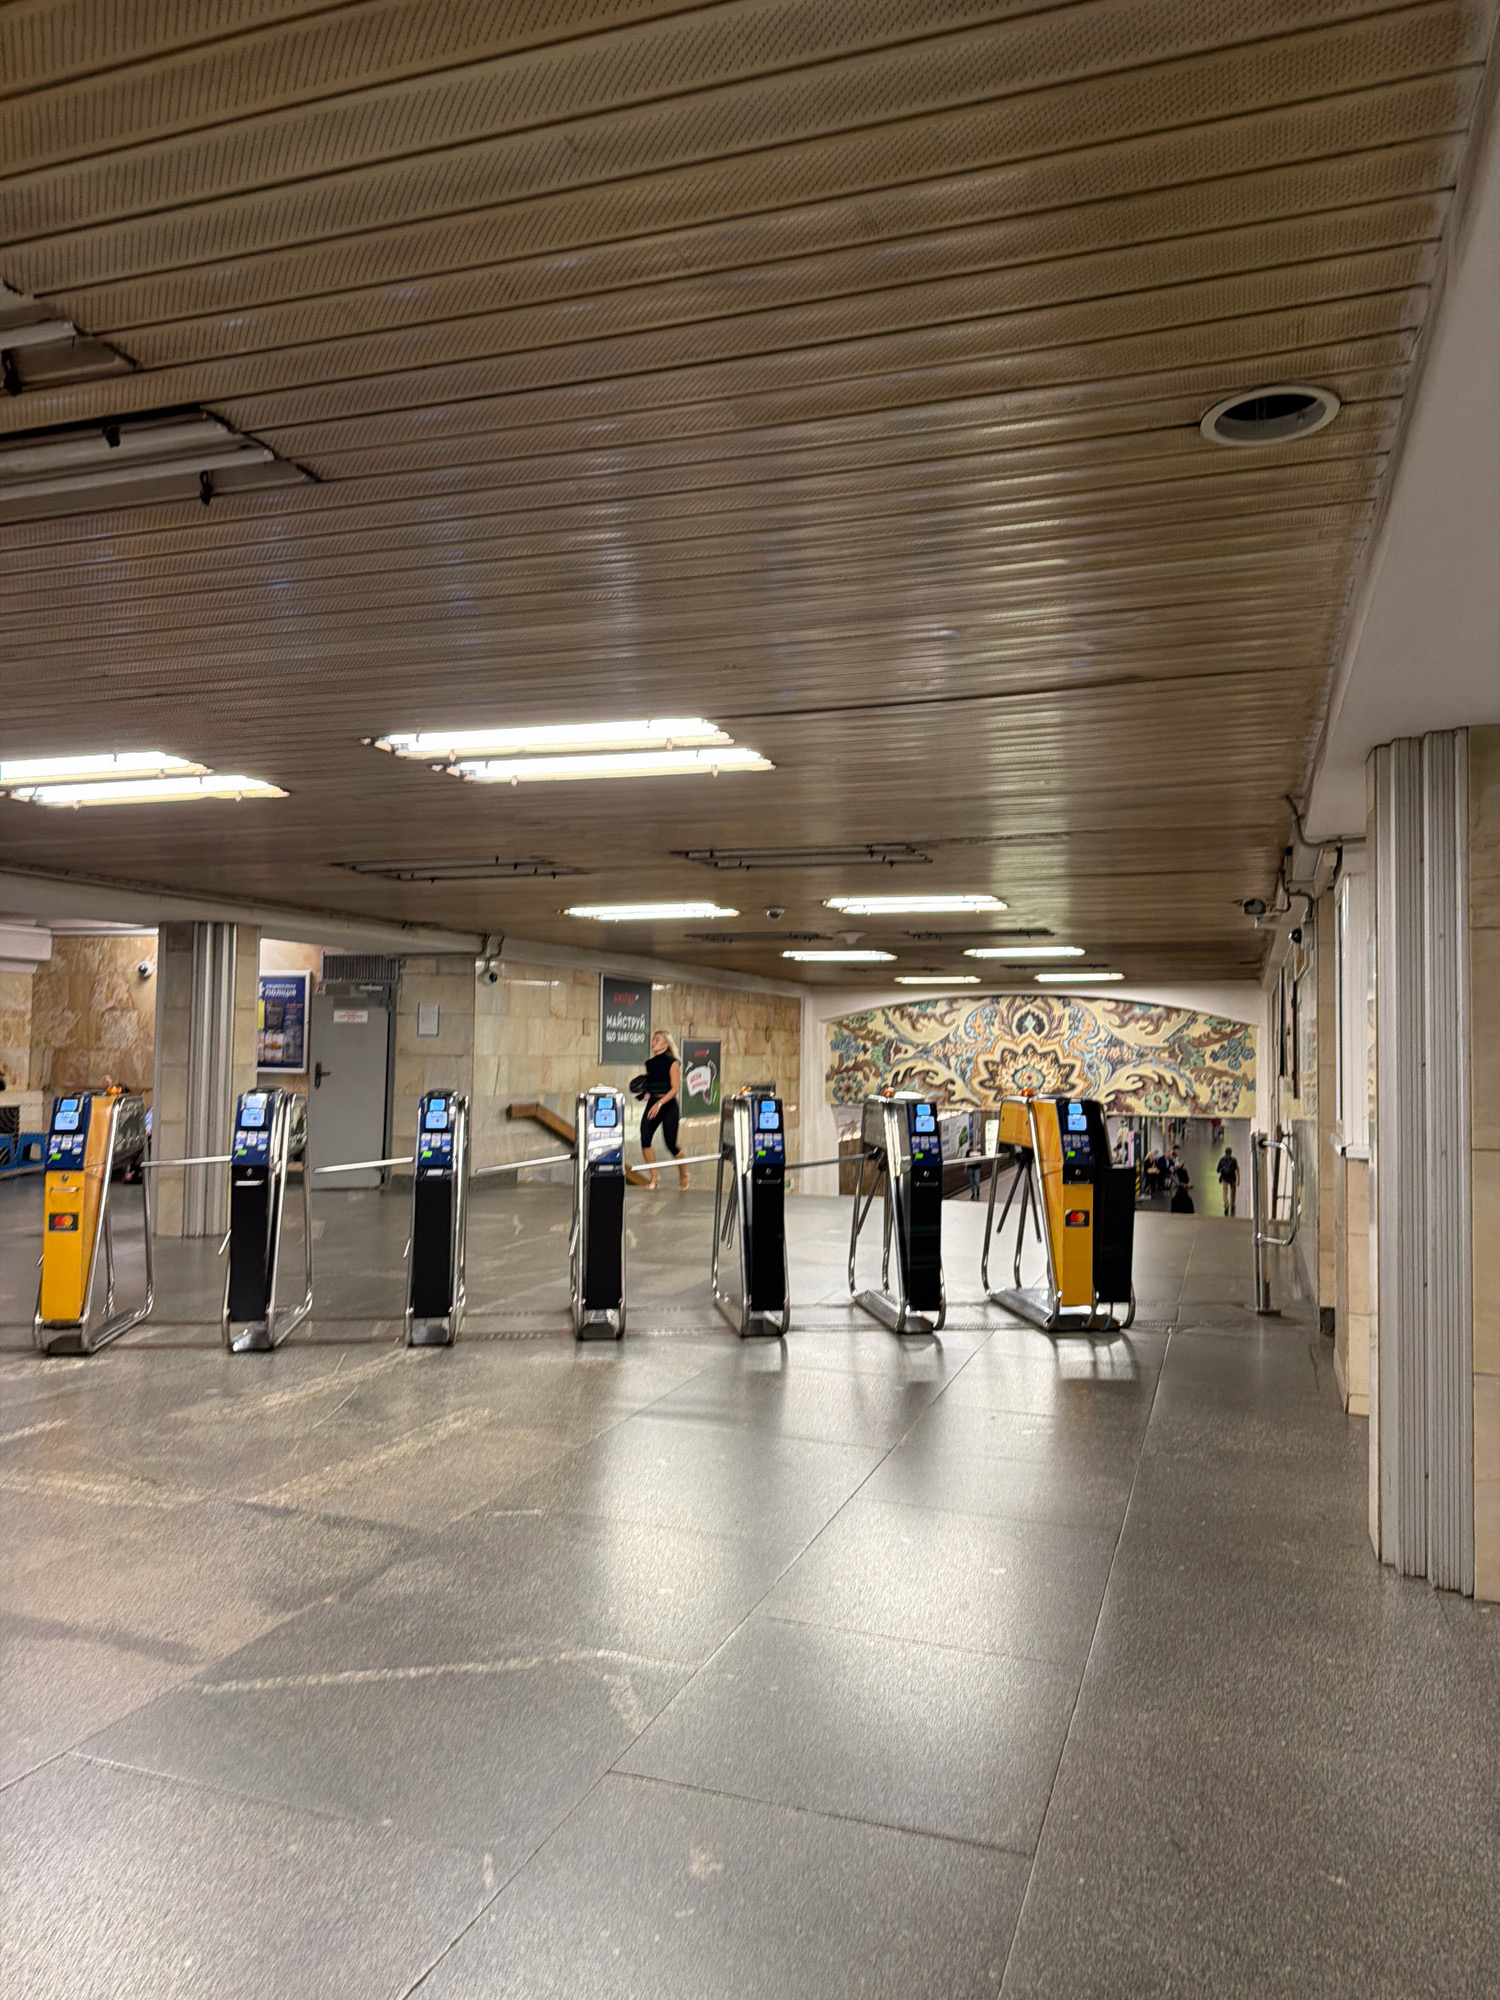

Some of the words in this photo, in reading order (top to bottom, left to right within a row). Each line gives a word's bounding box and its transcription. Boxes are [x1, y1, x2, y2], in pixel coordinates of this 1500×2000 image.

[606, 1011, 646, 1030] МАЙСТРУЙ
[606, 1031, 616, 1043] ЩО
[617, 1031, 646, 1044] ЗАВГОДНО
